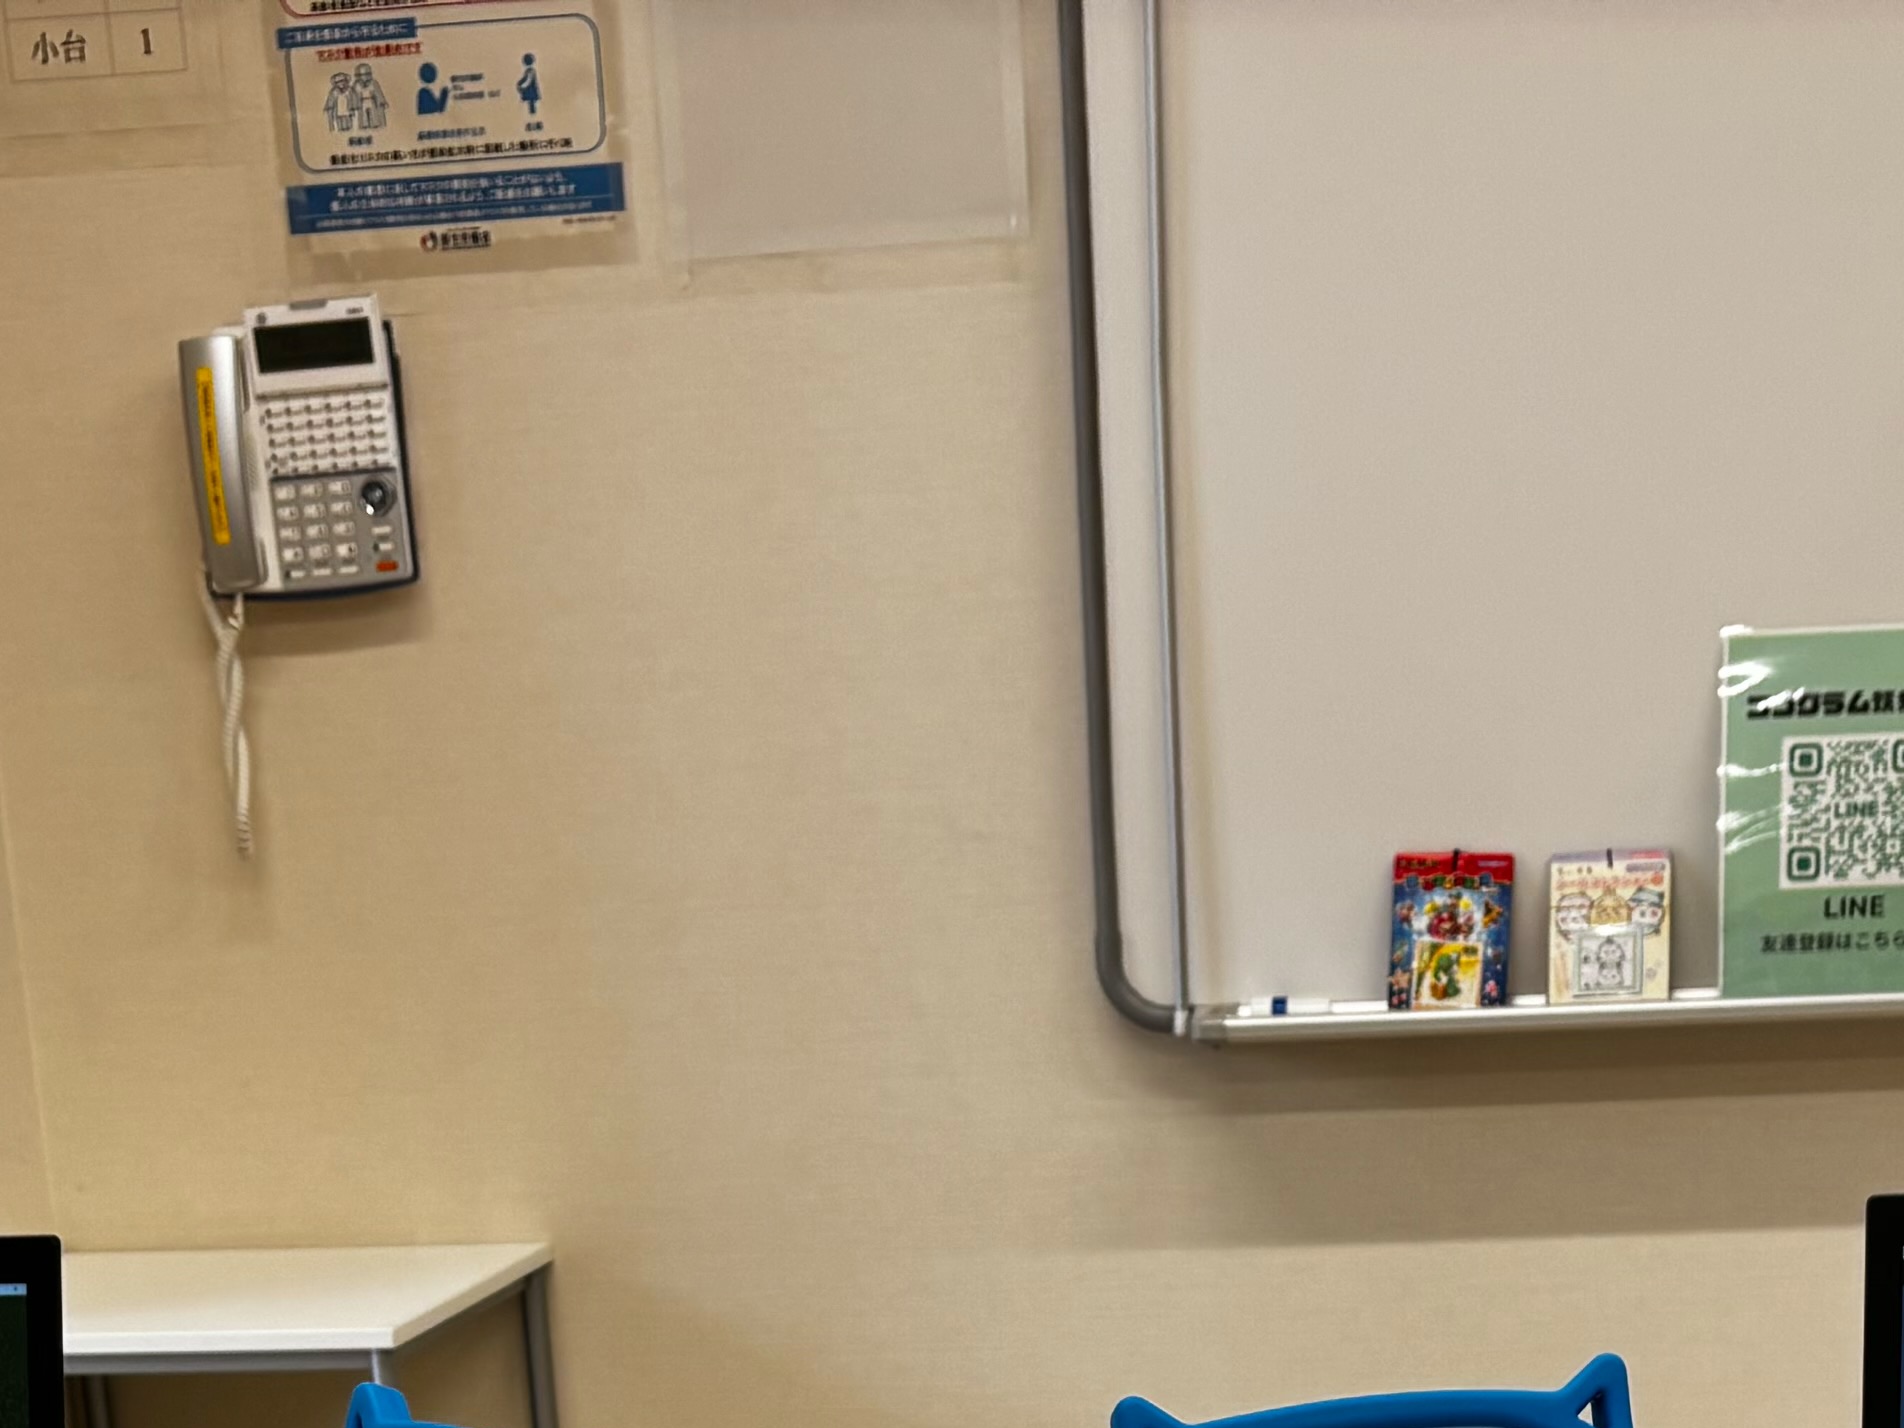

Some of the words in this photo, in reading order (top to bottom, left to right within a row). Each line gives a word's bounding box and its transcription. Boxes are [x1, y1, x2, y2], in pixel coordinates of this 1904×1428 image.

[31, 28, 86, 65] 小台
[140, 27, 153, 56] 1
[1834, 801, 1877, 818] LINE
[1824, 894, 1886, 919] LINE
